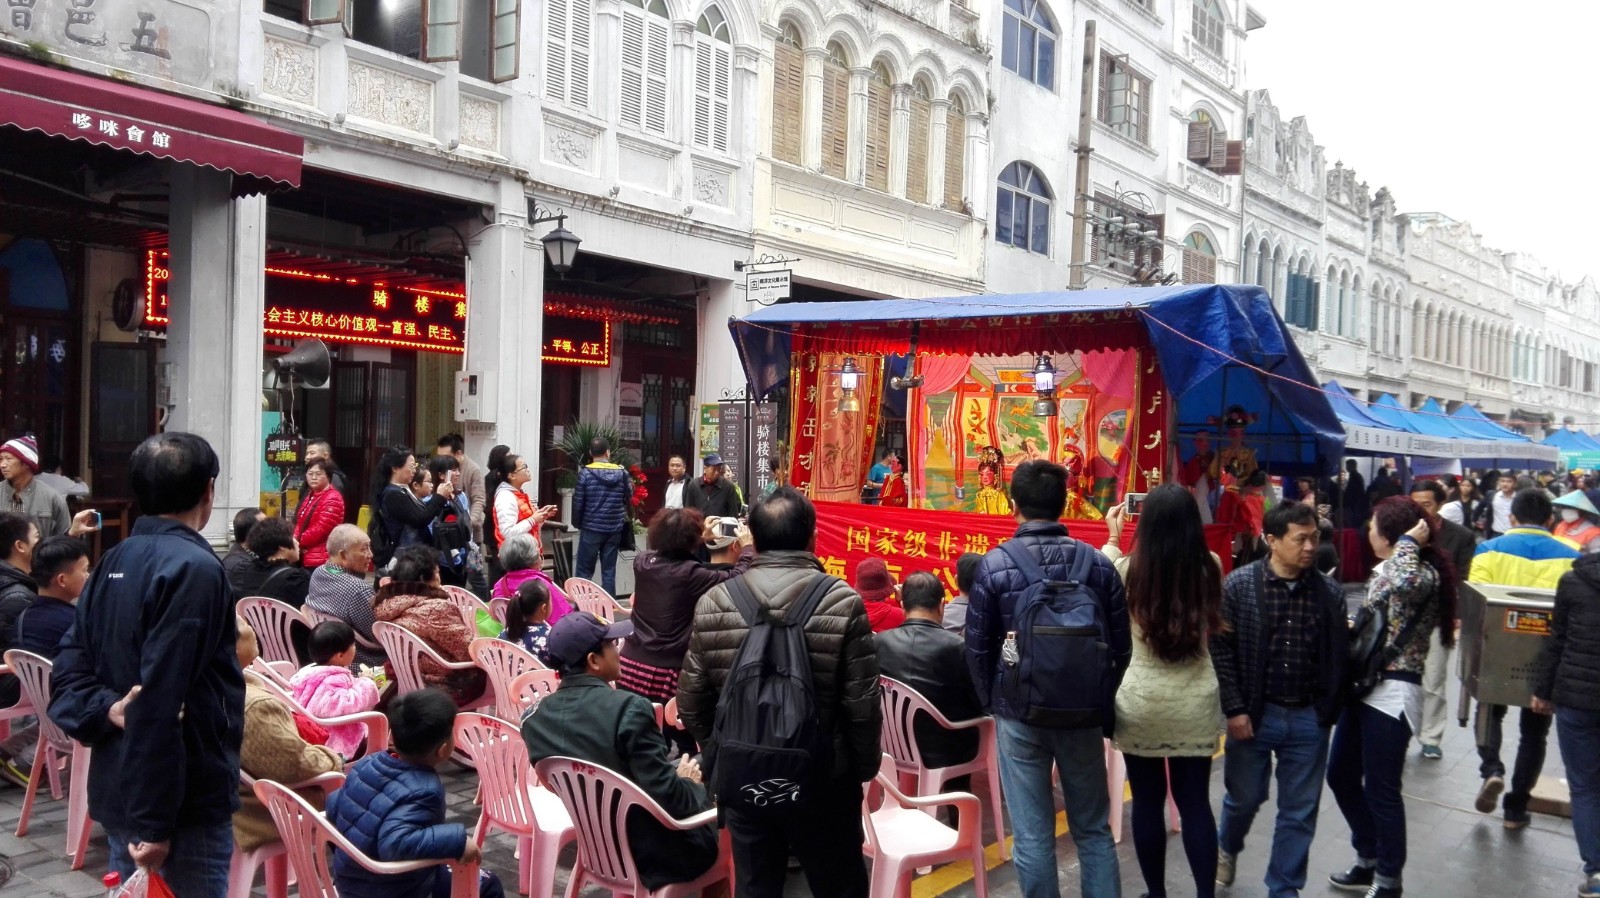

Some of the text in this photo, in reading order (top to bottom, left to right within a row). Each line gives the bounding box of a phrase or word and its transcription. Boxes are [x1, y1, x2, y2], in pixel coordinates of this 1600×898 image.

[72, 112, 171, 148] 哆咪會館
[373, 289, 467, 318] 骑楼集
[755, 424, 770, 490] 骑楼集市
